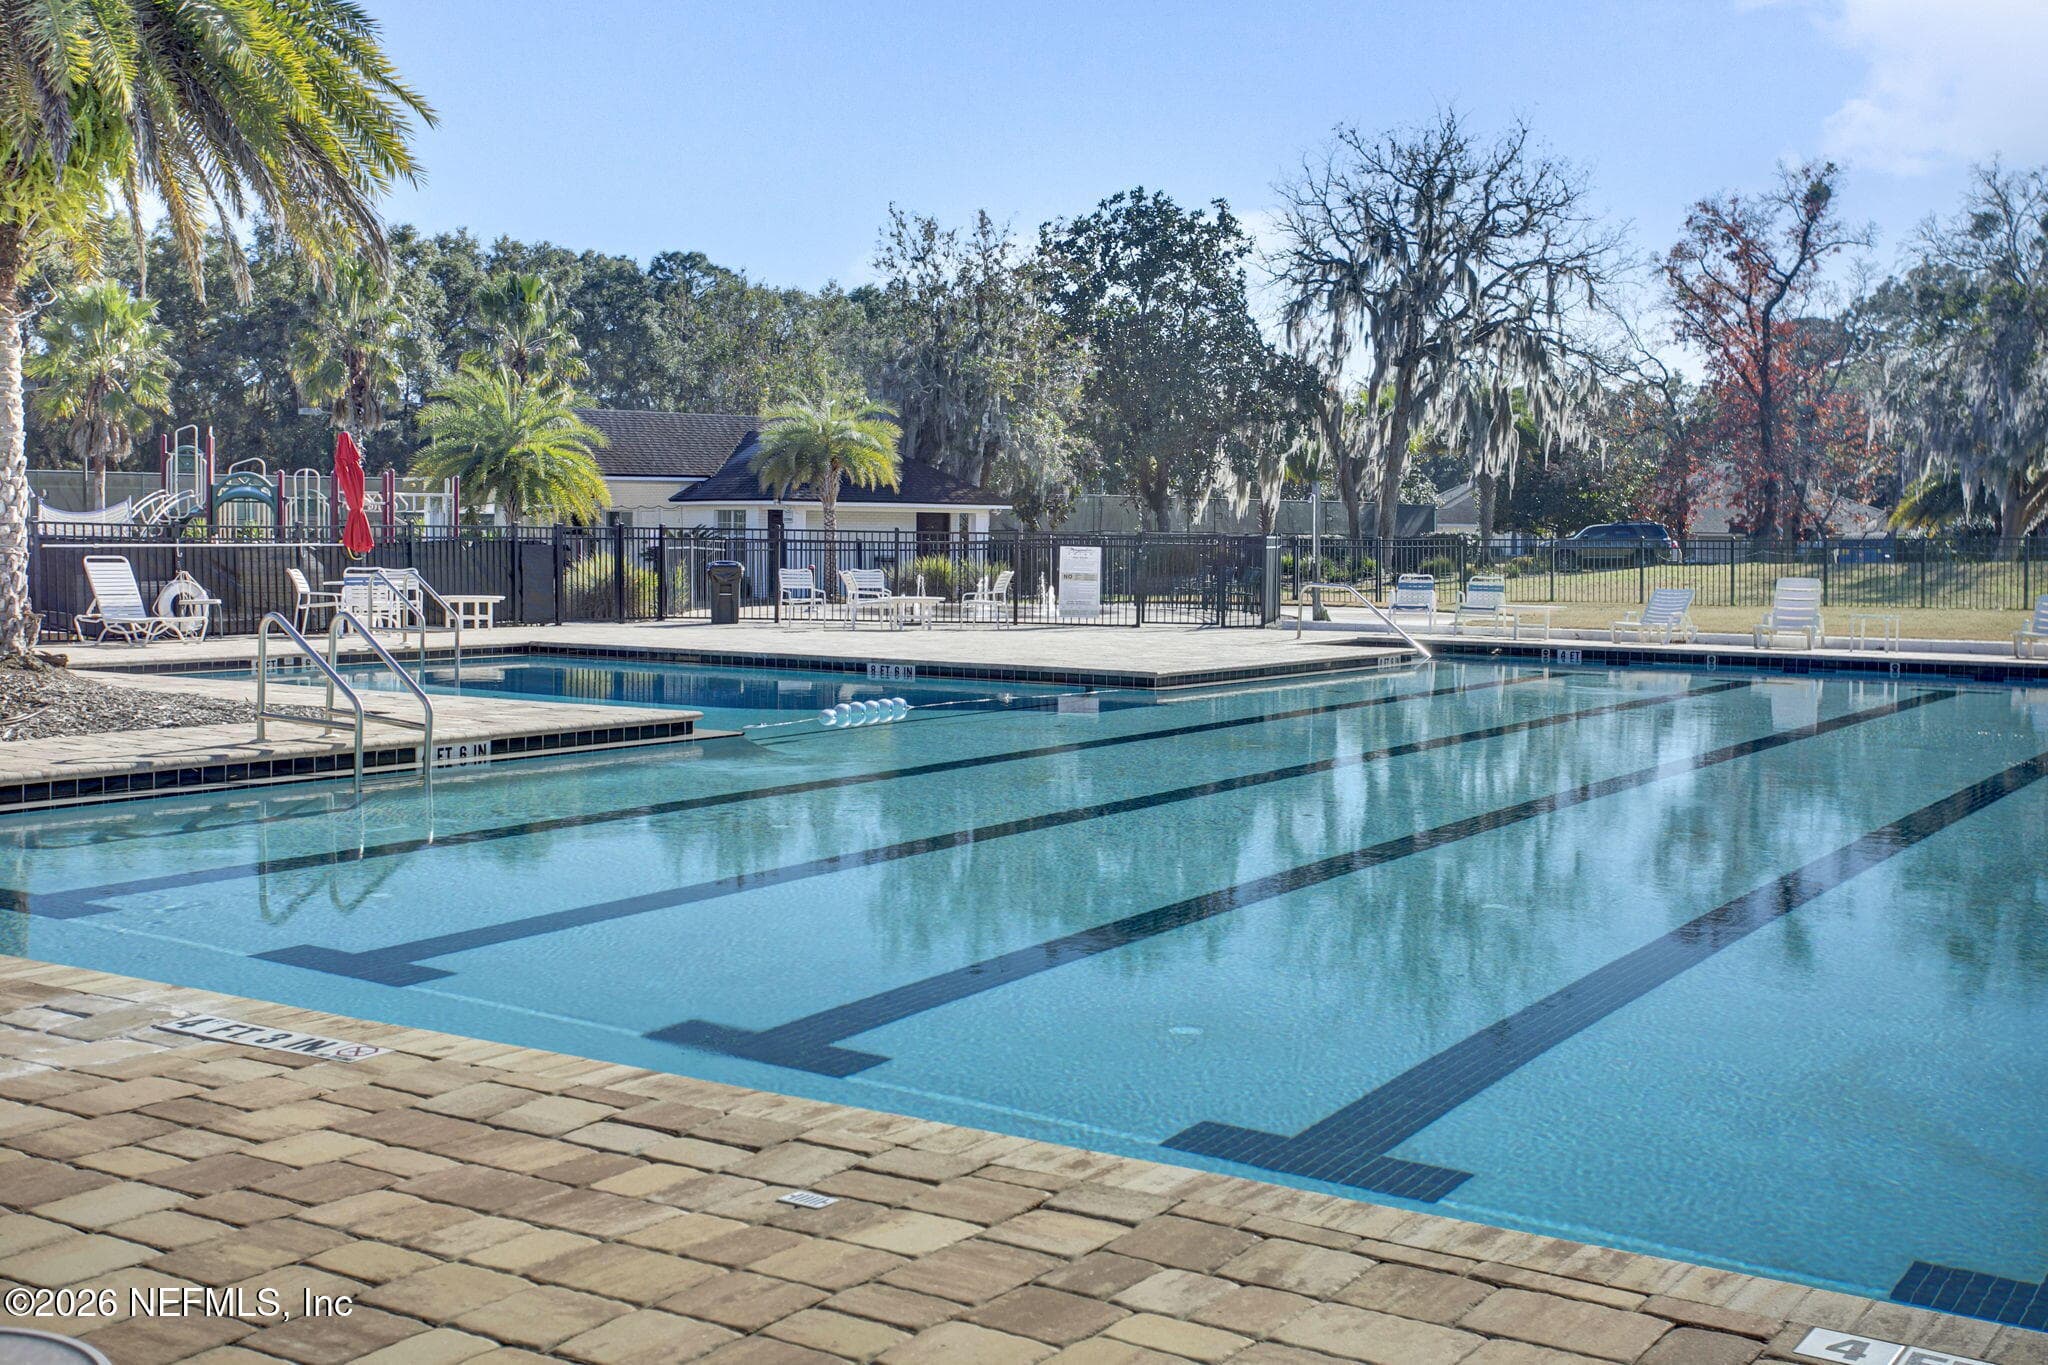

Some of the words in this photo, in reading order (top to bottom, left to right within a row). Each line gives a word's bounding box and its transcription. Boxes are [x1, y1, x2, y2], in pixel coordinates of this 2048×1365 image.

[880, 665, 891, 676] FT
[903, 666, 913, 677] IN
[437, 747, 453, 760] FT
[459, 745, 468, 758] 6
[473, 743, 487, 757] IN
[176, 1018, 216, 1029] 4
[254, 1033, 293, 1044] 3
[1825, 1339, 1871, 1361] 4
